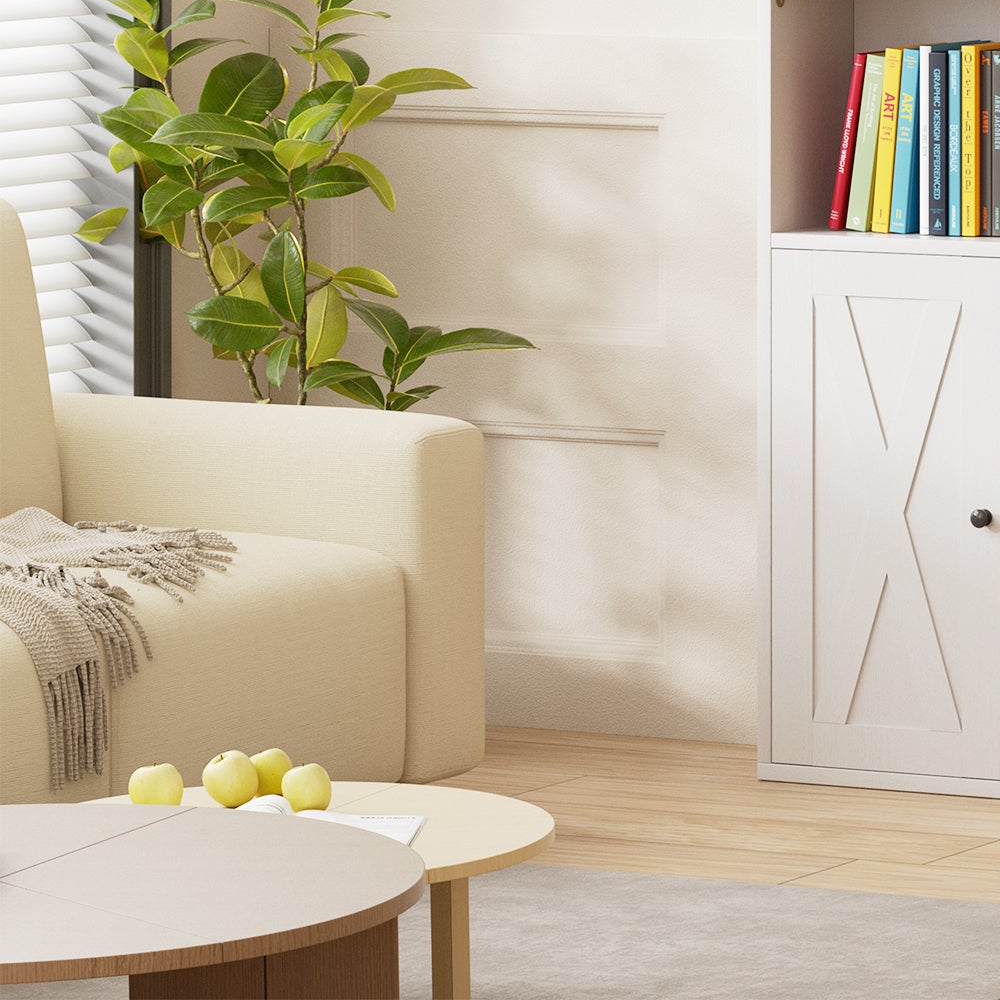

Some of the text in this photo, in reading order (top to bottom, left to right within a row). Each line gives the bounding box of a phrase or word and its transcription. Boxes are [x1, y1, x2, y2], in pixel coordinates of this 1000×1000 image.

[883, 92, 895, 121] ART
[933, 69, 941, 107] GRAPHIC
[902, 93, 913, 122] ART
[933, 109, 941, 141] DESIGN
[838, 109, 853, 174] FRANK LLOYD WRIGHT
[950, 124, 958, 172] BORDEAUX
[933, 144, 941, 200] REFERENCED
